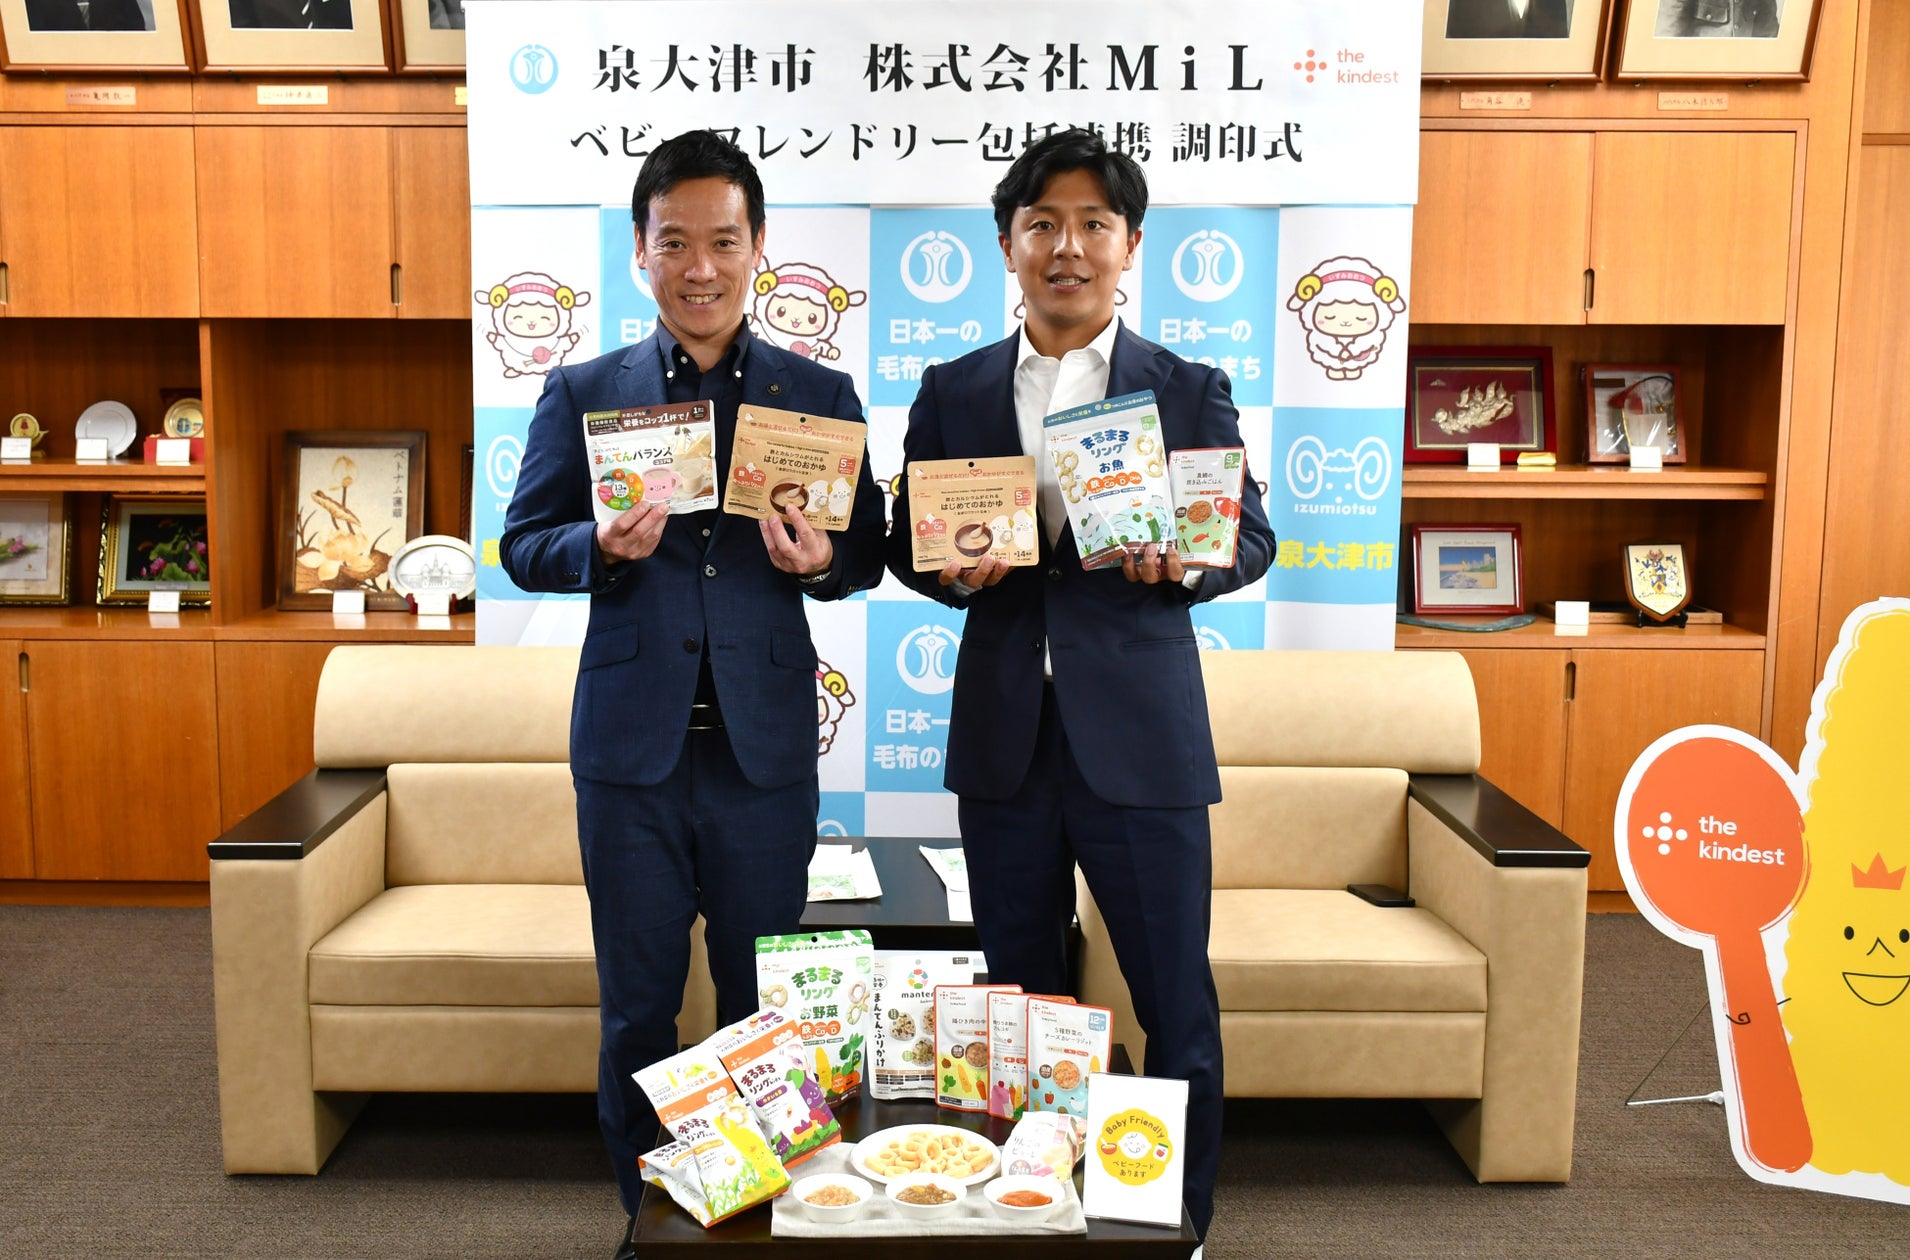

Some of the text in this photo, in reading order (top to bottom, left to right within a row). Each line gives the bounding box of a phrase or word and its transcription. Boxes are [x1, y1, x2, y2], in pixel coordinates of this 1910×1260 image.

[1337, 49, 1365, 63] the
[593, 43, 816, 93] 泉大津市
[1337, 69, 1399, 84] kindest
[1172, 122, 1304, 162] 調印式
[889, 319, 982, 344] 日本一の
[1160, 318, 1252, 343] 日本一の
[1080, 428, 1130, 450] まるまる
[594, 446, 673, 465] まんてんバランス
[1091, 442, 1127, 459] リング
[763, 455, 827, 471] はじめてのおかゆ
[1099, 459, 1125, 475] お魚
[941, 500, 1003, 511] はじめてのおかゆ
[1276, 540, 1394, 570] 泉大津市
[1698, 815, 1737, 836] the
[1698, 840, 1785, 866] kindest
[791, 966, 843, 989] まるまる
[801, 987, 834, 1001] リング
[800, 1004, 839, 1021] お野菜
[873, 993, 886, 1068] まんてんふりかけ
[741, 1062, 776, 1087] まるまる
[749, 1078, 770, 1095] リング
[1106, 1115, 1165, 1139] Baby Friendly
[1112, 1160, 1154, 1169] ベビーフード
[1119, 1169, 1147, 1178] あります
